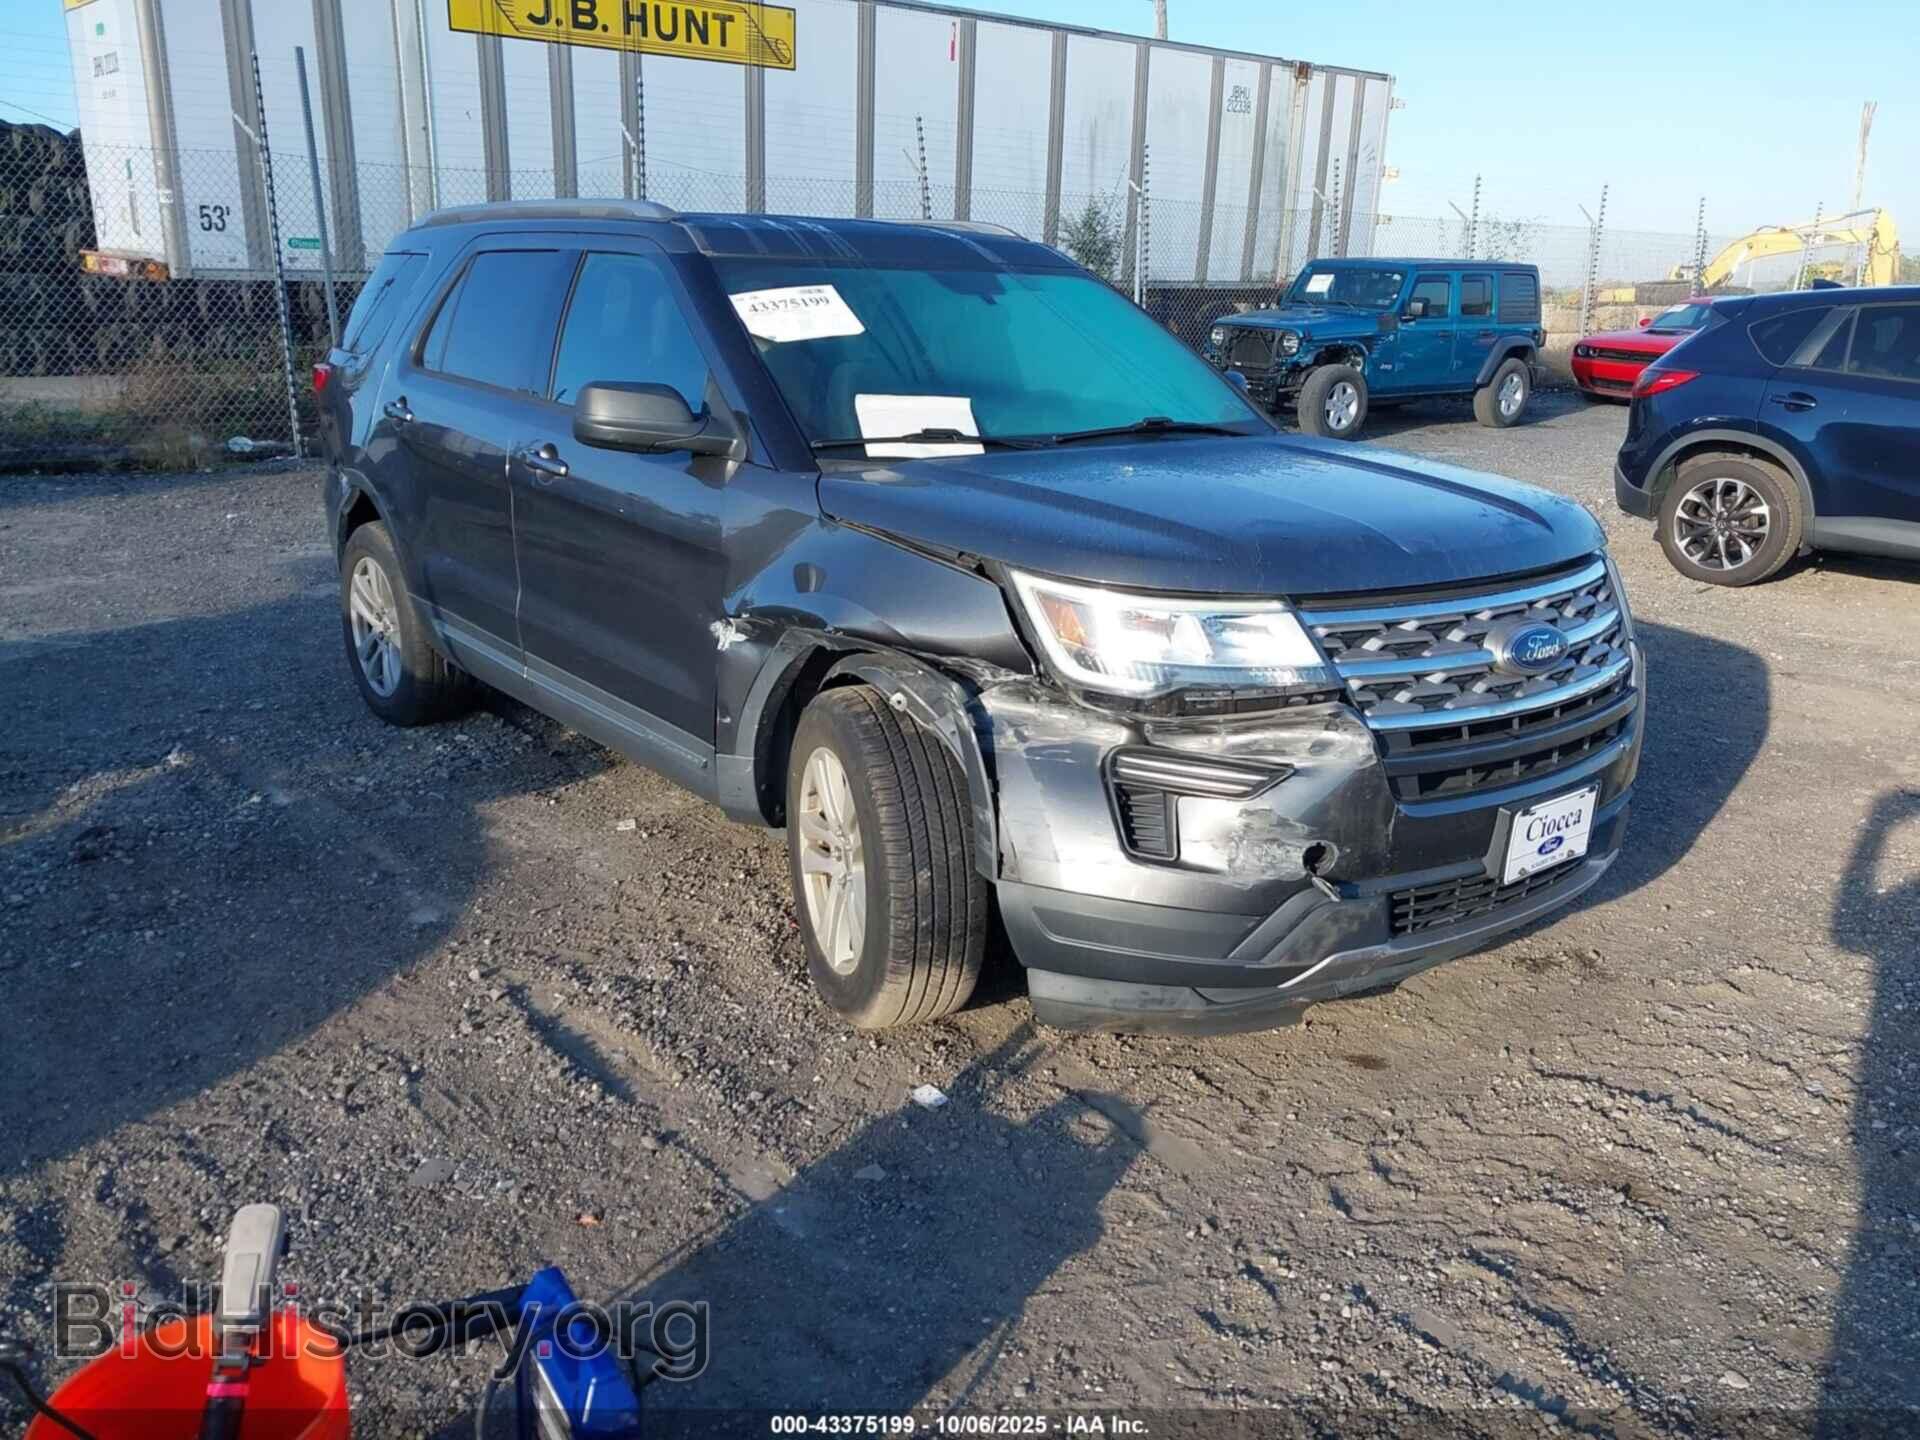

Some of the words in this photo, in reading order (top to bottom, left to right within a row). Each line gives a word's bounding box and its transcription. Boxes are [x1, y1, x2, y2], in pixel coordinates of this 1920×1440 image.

[526, 0, 609, 33] J.B.
[623, 1, 735, 48] HUNT
[199, 204, 231, 233] 53'
[748, 295, 830, 313] 43375199
[1521, 633, 1561, 662] Ford
[1526, 808, 1583, 842] Ciocca
